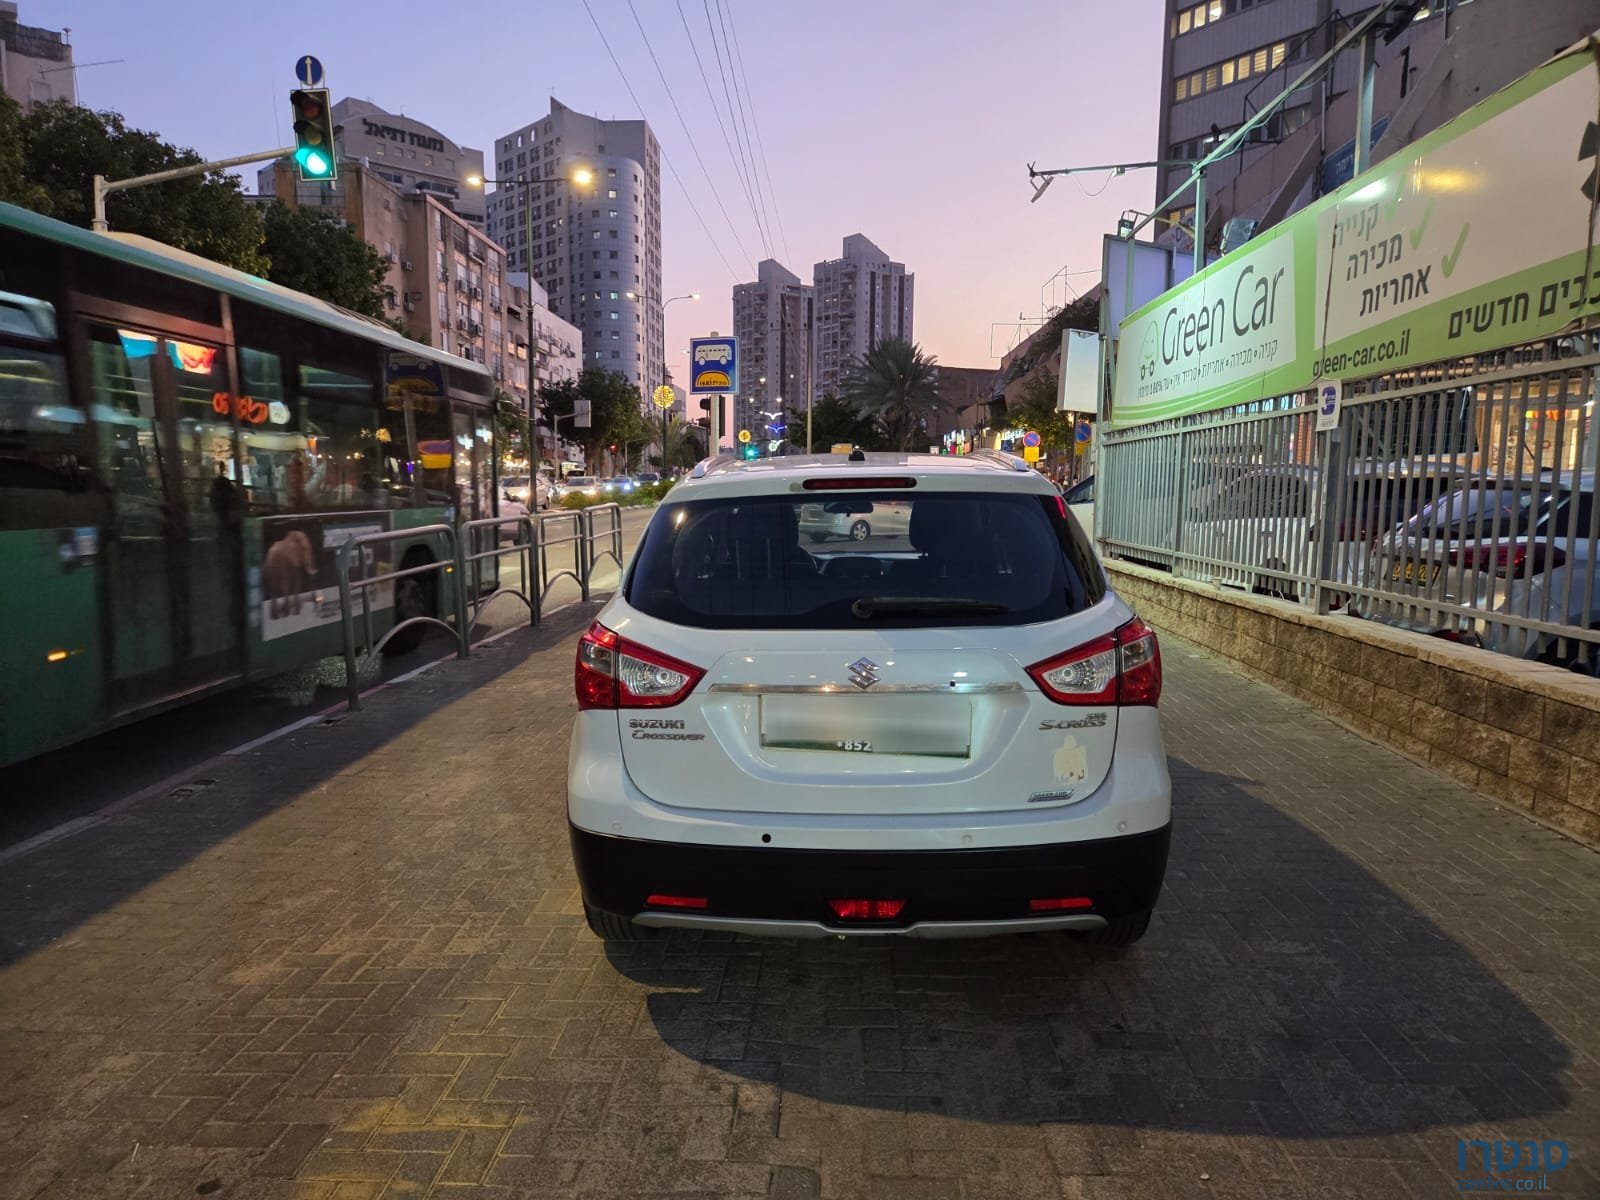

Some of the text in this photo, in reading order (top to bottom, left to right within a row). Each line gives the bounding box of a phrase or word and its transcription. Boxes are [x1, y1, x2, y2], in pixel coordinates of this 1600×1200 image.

[1347, 233, 1403, 282] מכירה
[1360, 264, 1432, 317] אחריות
[1162, 264, 1285, 366] Green Car
[1448, 292, 1530, 340] חדשים
[1201, 357, 1226, 379] אחריות
[1230, 348, 1253, 369] מכירה
[1258, 339, 1278, 362] קניה
[629, 718, 685, 730] SUZUKI
